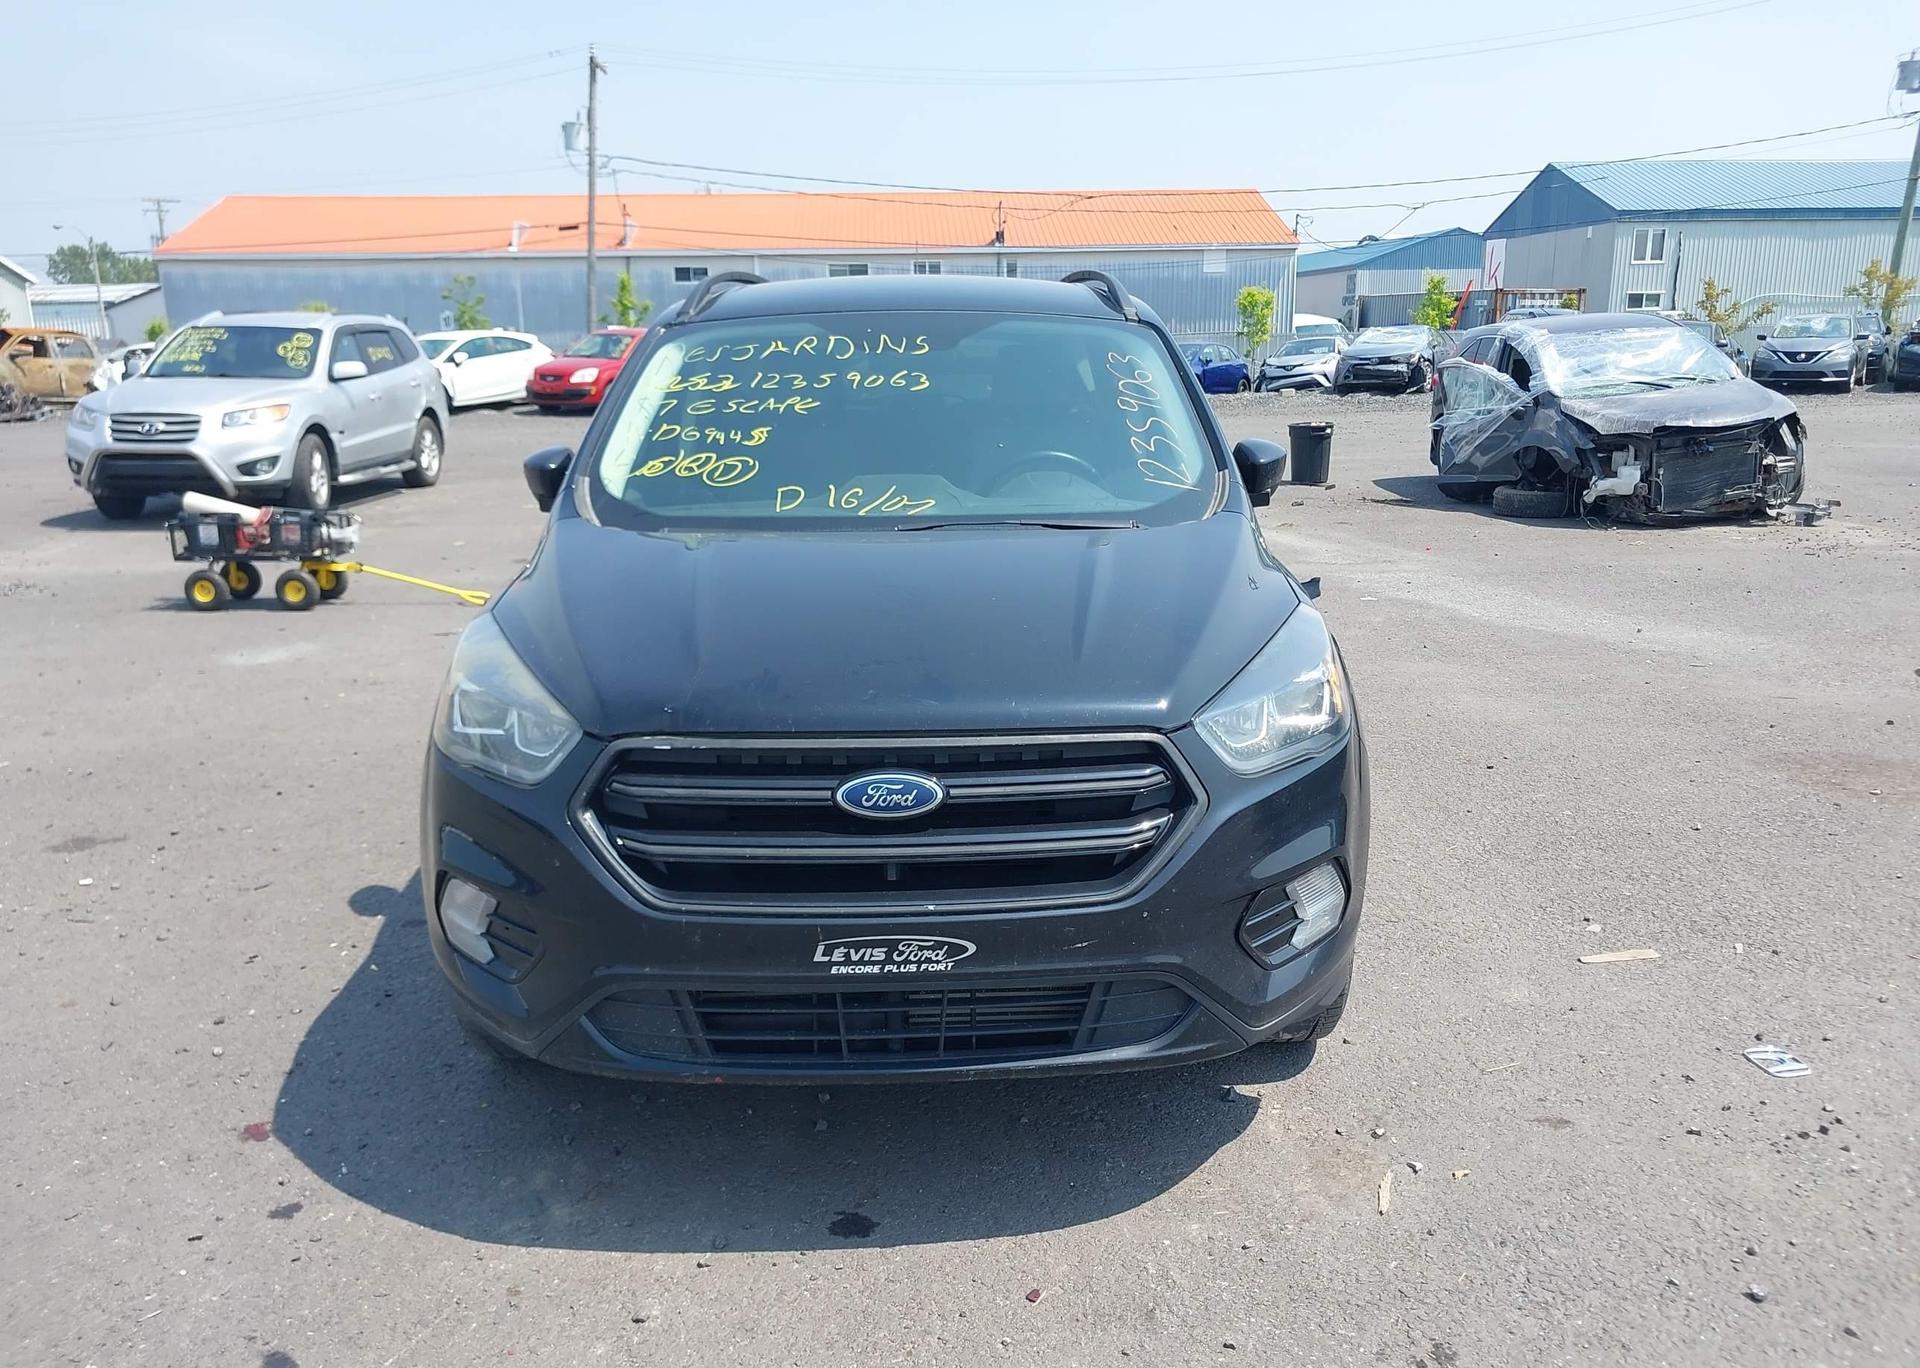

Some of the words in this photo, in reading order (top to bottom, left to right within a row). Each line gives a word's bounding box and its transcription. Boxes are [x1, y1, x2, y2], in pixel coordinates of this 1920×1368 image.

[862, 783, 918, 807] Ford
[813, 944, 889, 962] LÉVIS
[892, 940, 949, 962] Ford
[830, 965, 882, 974] ENCORE
[883, 963, 918, 973] PLUS
[919, 962, 956, 972] FORT
